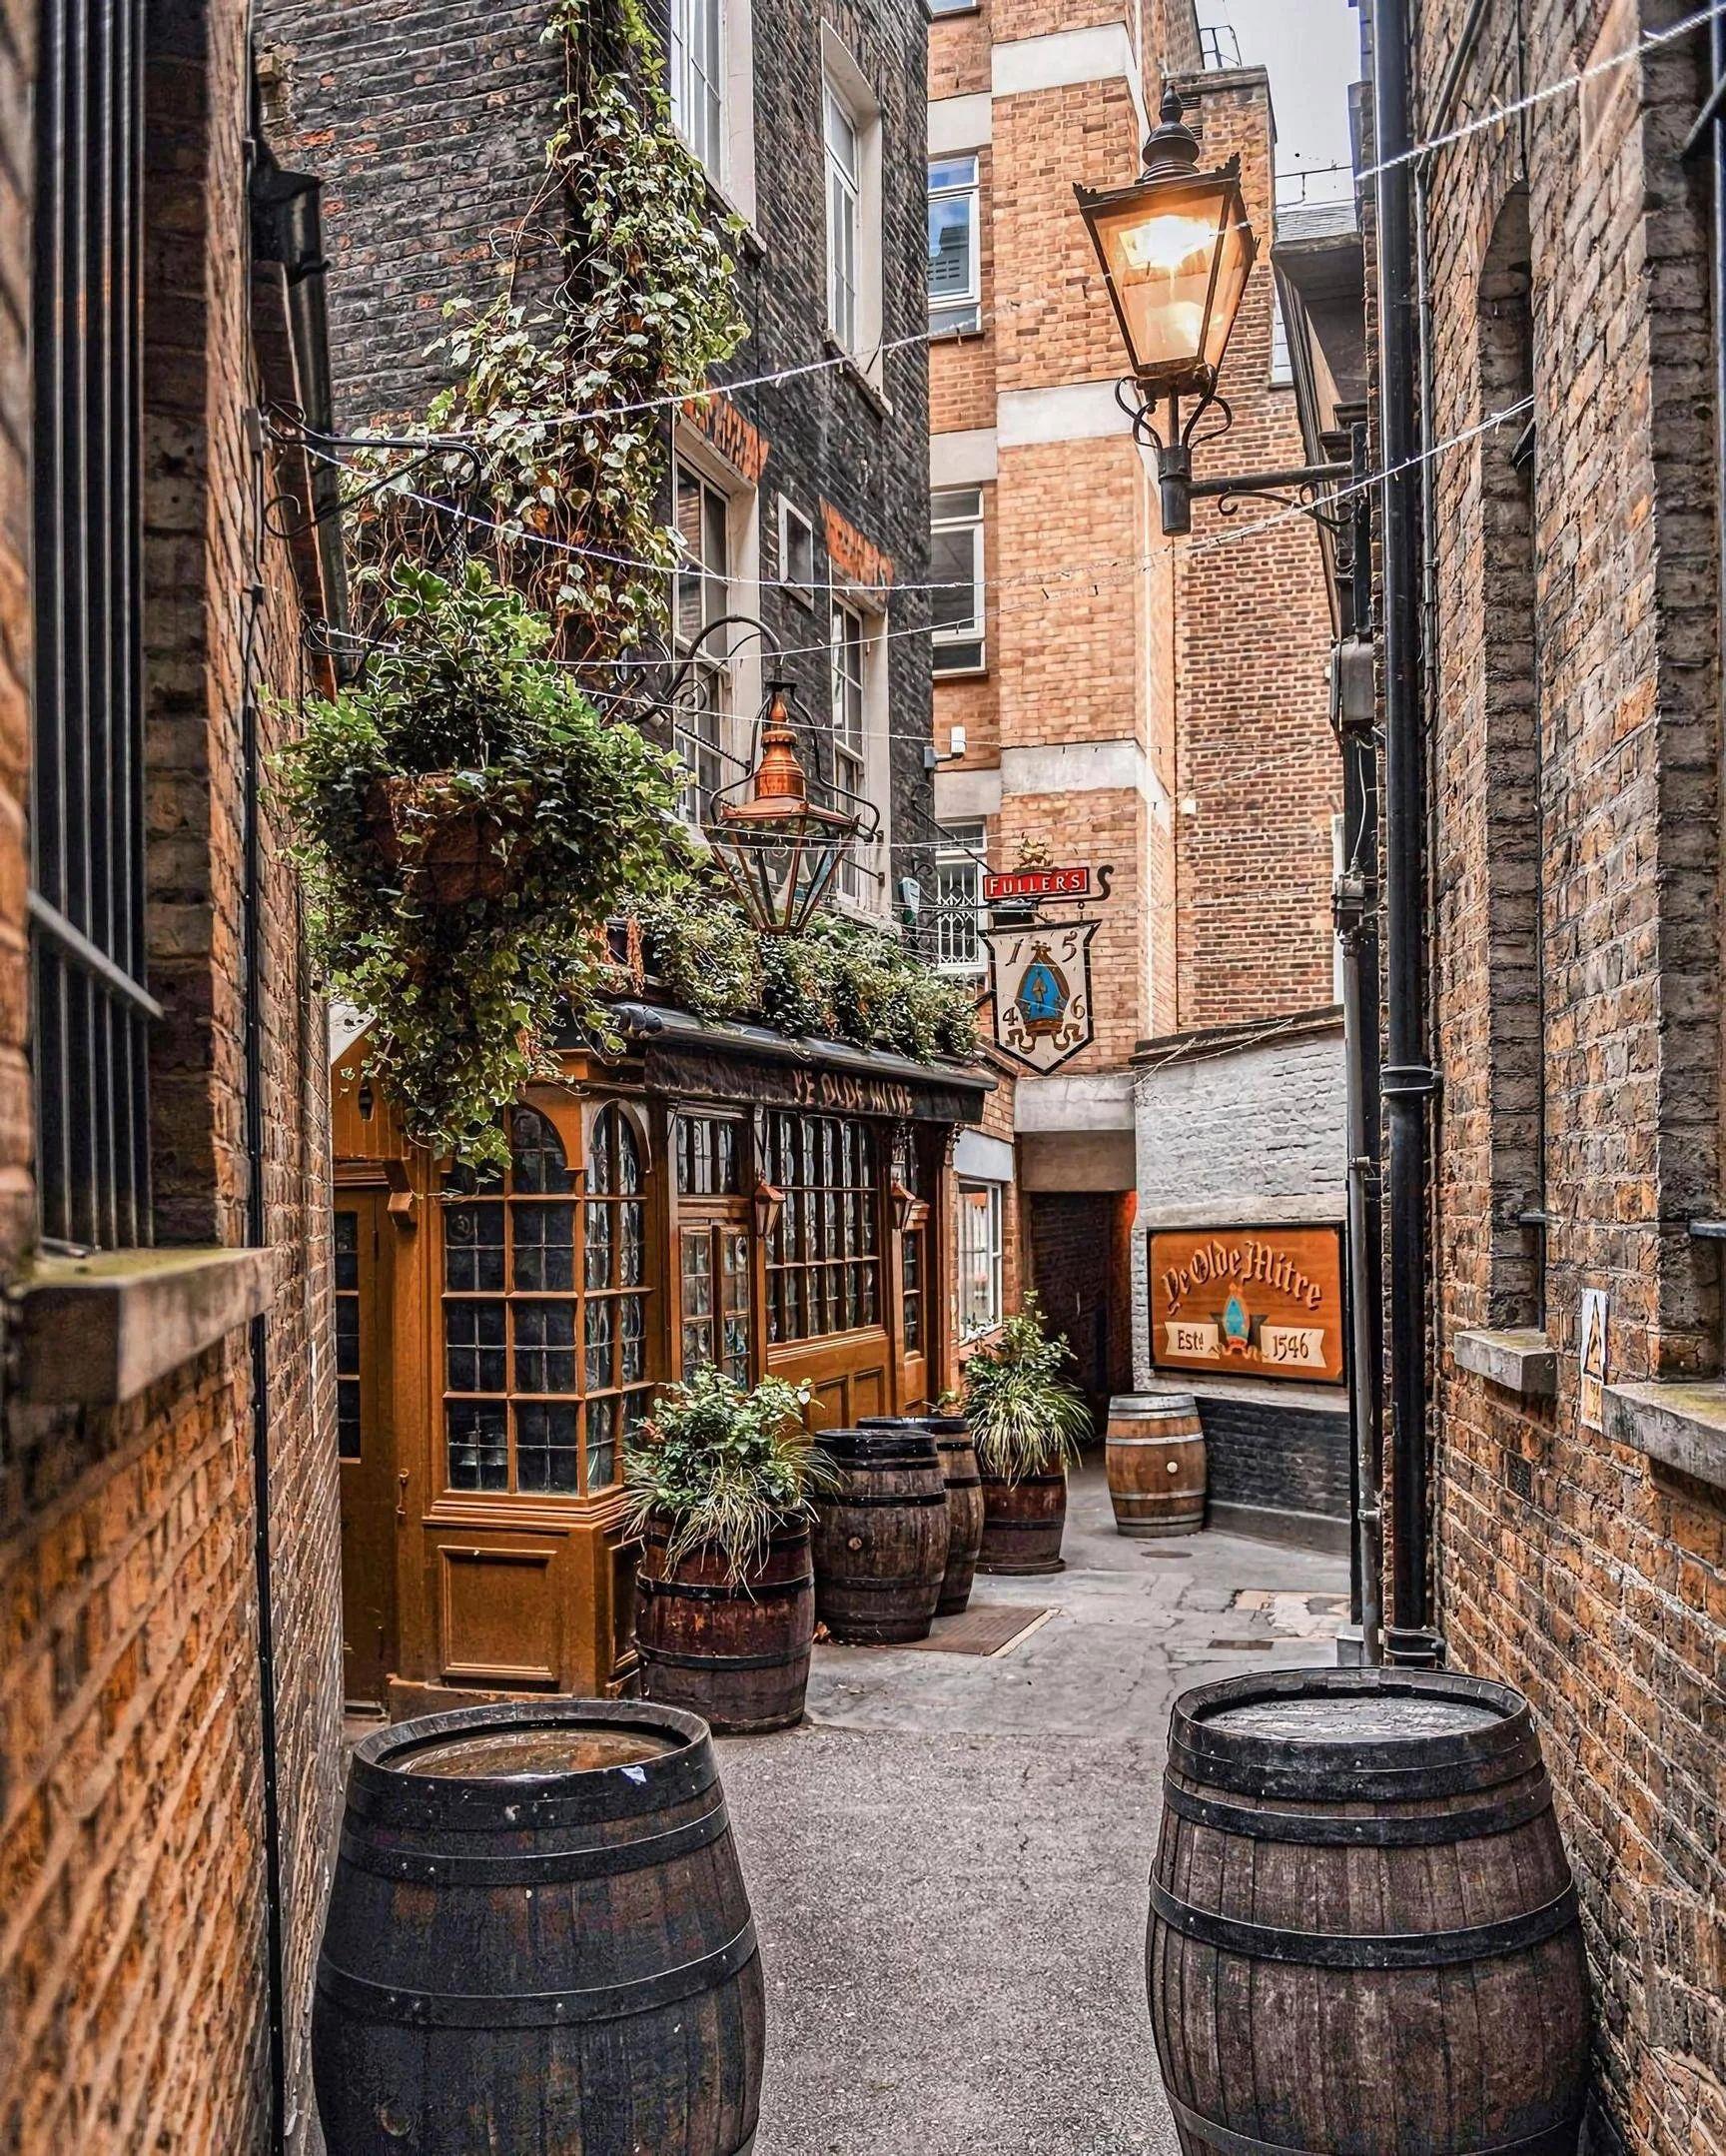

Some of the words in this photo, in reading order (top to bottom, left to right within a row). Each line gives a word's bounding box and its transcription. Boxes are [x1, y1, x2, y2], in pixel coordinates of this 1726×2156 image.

[989, 873, 1082, 894] FULLER'S
[820, 1072, 865, 1109] OLDE
[869, 1080, 914, 1116] MITRE
[1162, 1267, 1192, 1317] Ye
[1190, 1239, 1242, 1285] Olde
[1242, 1240, 1322, 1310] Mitre
[1272, 1332, 1310, 1362] 1546
